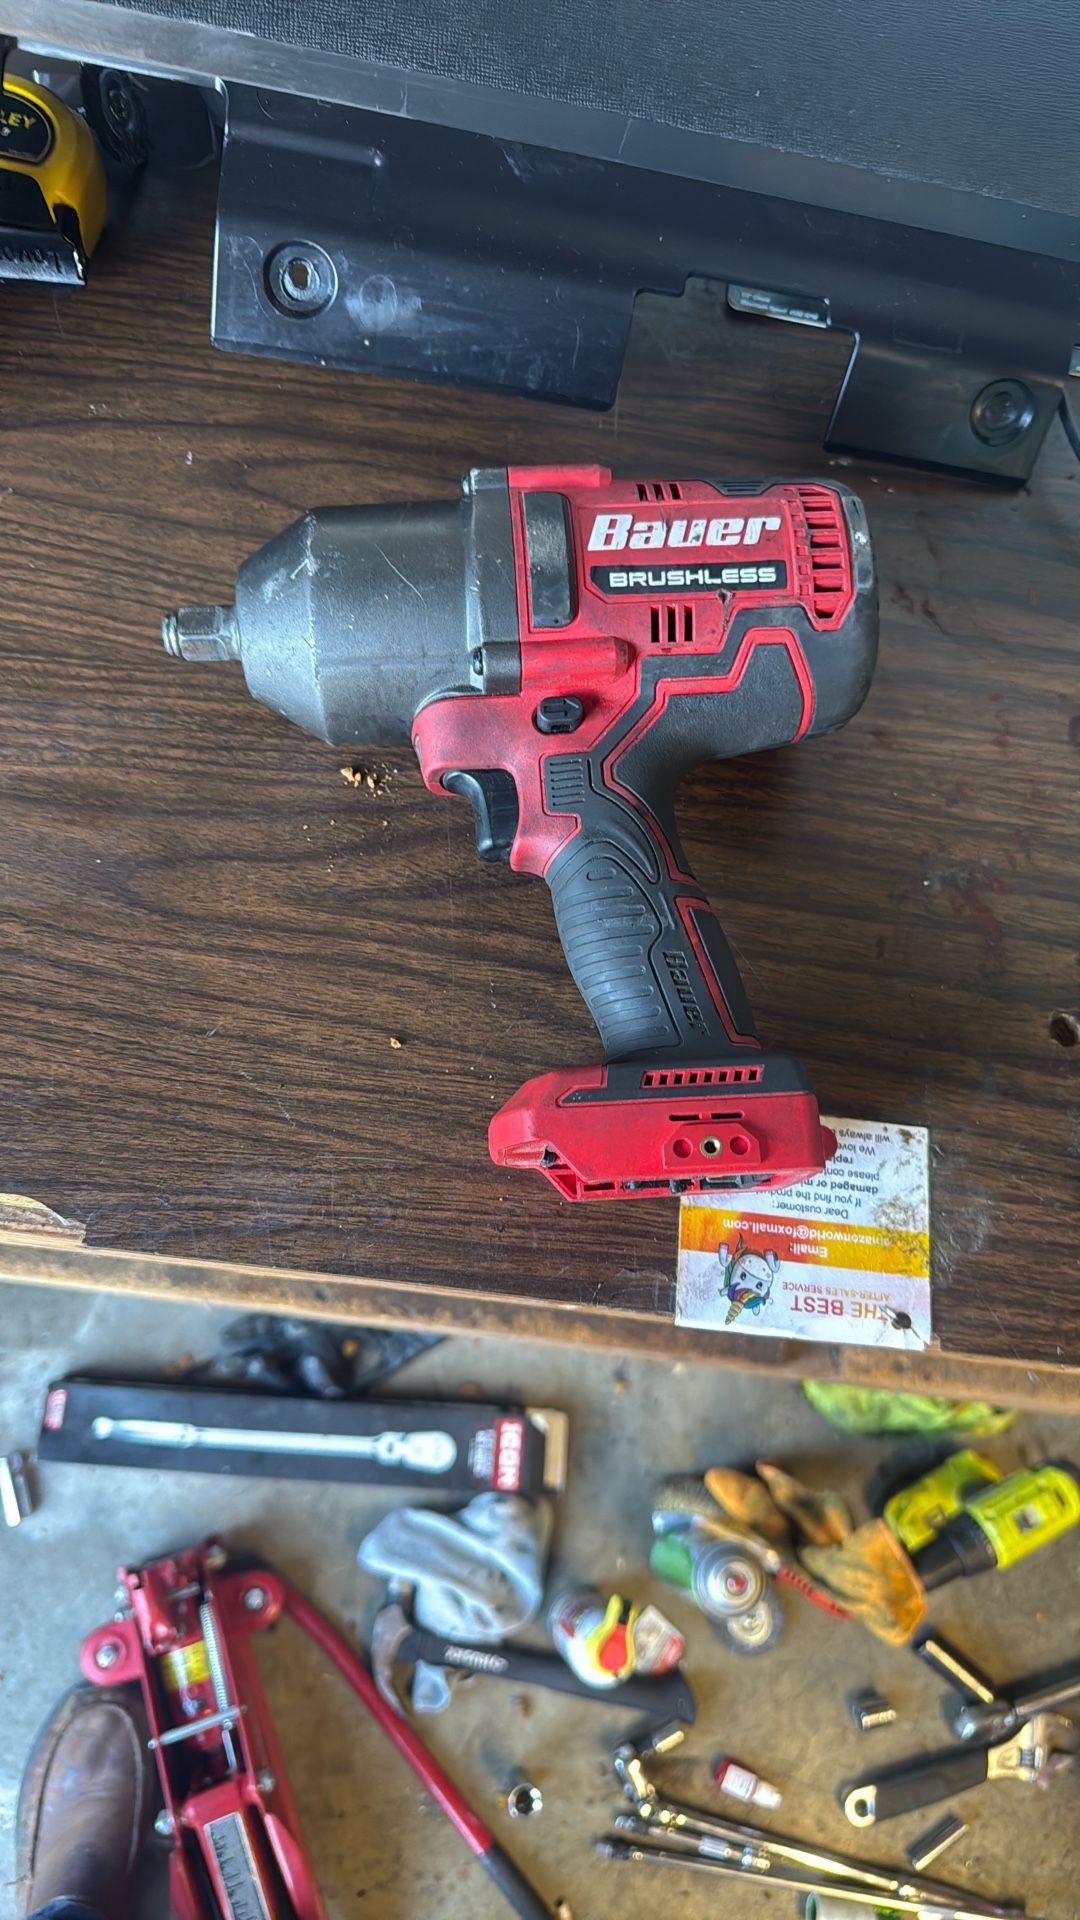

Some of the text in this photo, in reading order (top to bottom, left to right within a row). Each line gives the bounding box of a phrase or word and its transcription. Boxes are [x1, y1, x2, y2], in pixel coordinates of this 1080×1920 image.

[587, 514, 781, 551] Bauer
[609, 567, 777, 587] BRUSHLESS
[662, 950, 710, 1037] Bauer
[839, 1129, 872, 1142] always
[875, 1134, 891, 1143] will
[859, 1147, 876, 1156] We
[833, 1156, 853, 1165] repl
[824, 1168, 880, 1182] please cont
[795, 1189, 811, 1200] the
[831, 1181, 879, 1195] damaged
[813, 1191, 832, 1203] find
[835, 1194, 853, 1206] you
[854, 1197, 862, 1207] If
[771, 1200, 849, 1219] Dear customer:
[722, 1219, 892, 1245] amazonworld@foxmail.com
[789, 1243, 828, 1258] Email:
[782, 1281, 891, 1301] AFTER-SALES SERVICE
[790, 1295, 889, 1321] THE BEST
